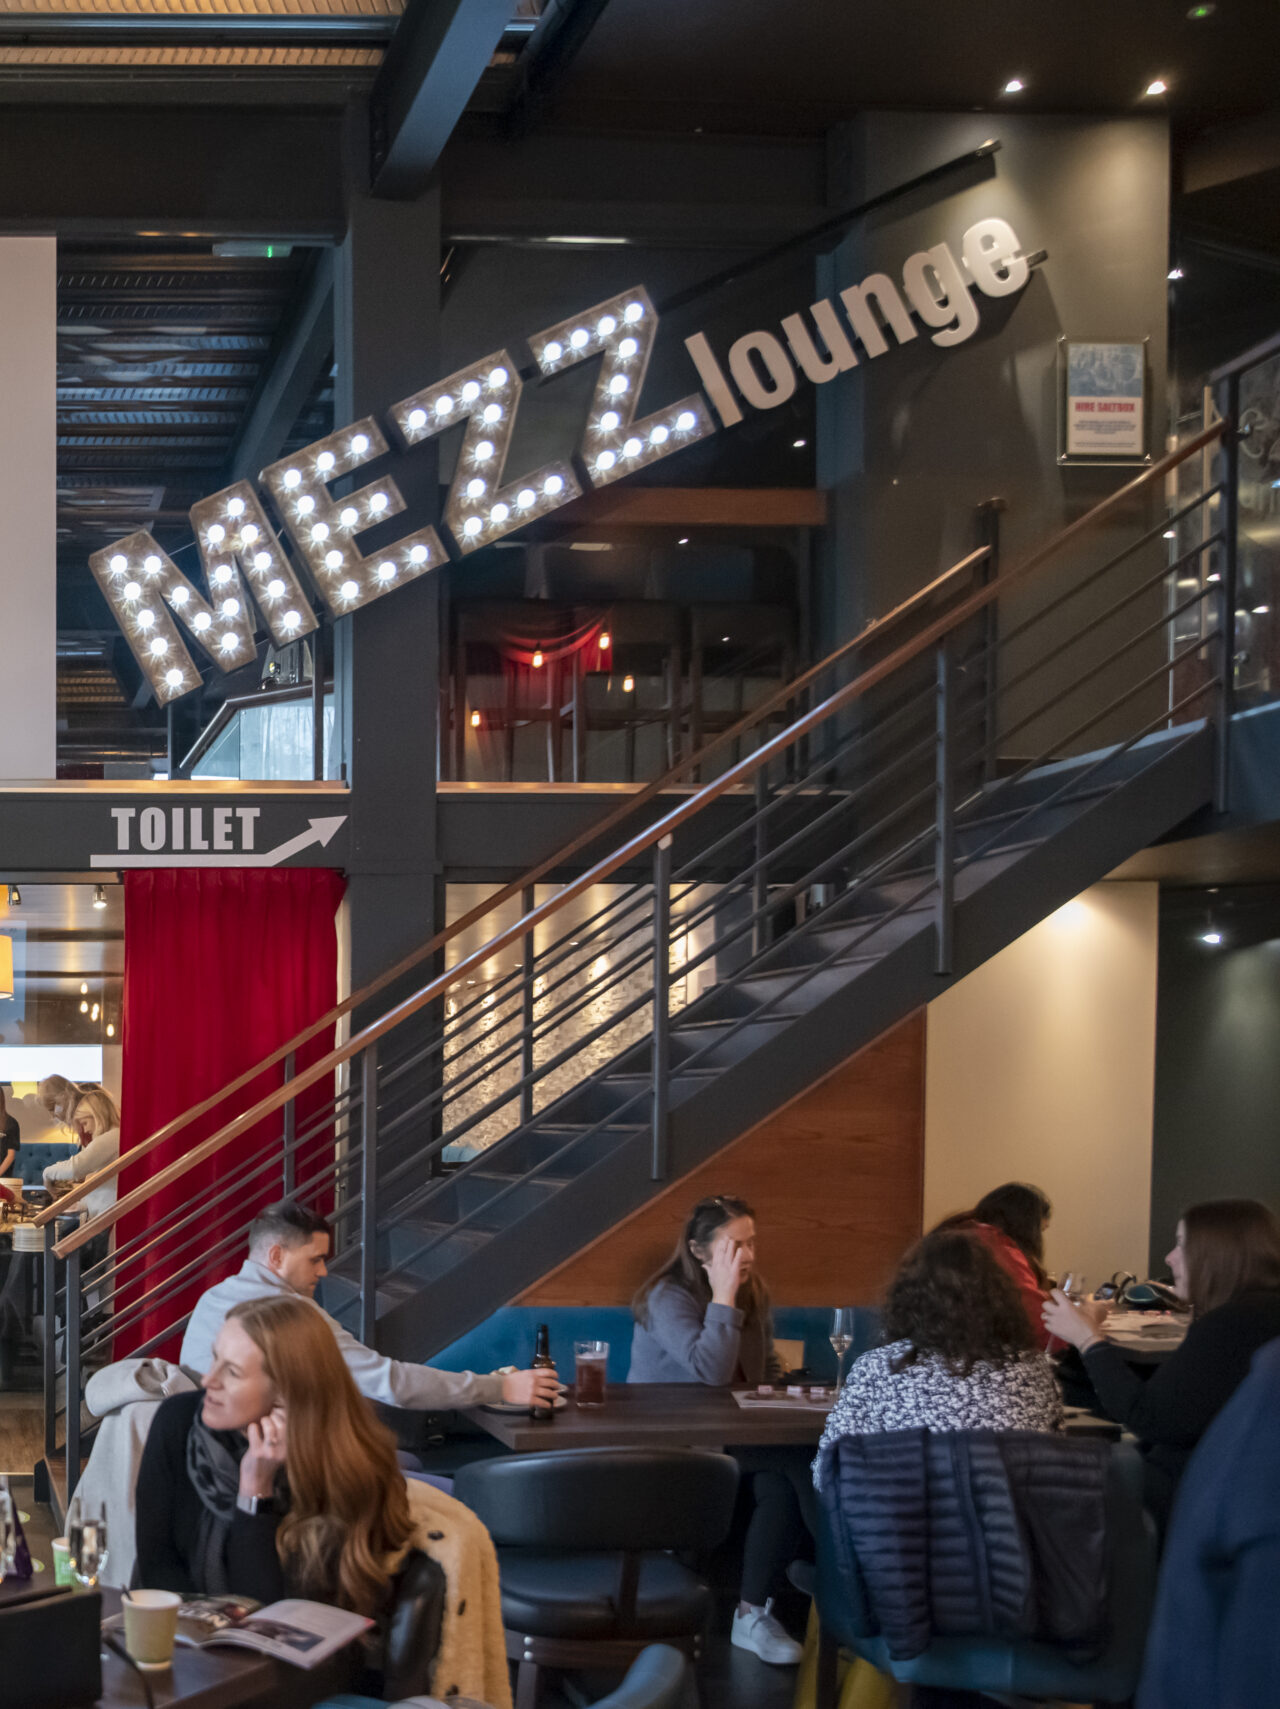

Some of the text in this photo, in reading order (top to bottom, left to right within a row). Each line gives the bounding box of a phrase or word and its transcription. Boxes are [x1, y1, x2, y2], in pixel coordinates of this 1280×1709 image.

[89, 217, 1031, 708] MEZZ lounge
[111, 807, 260, 850] TOILET
